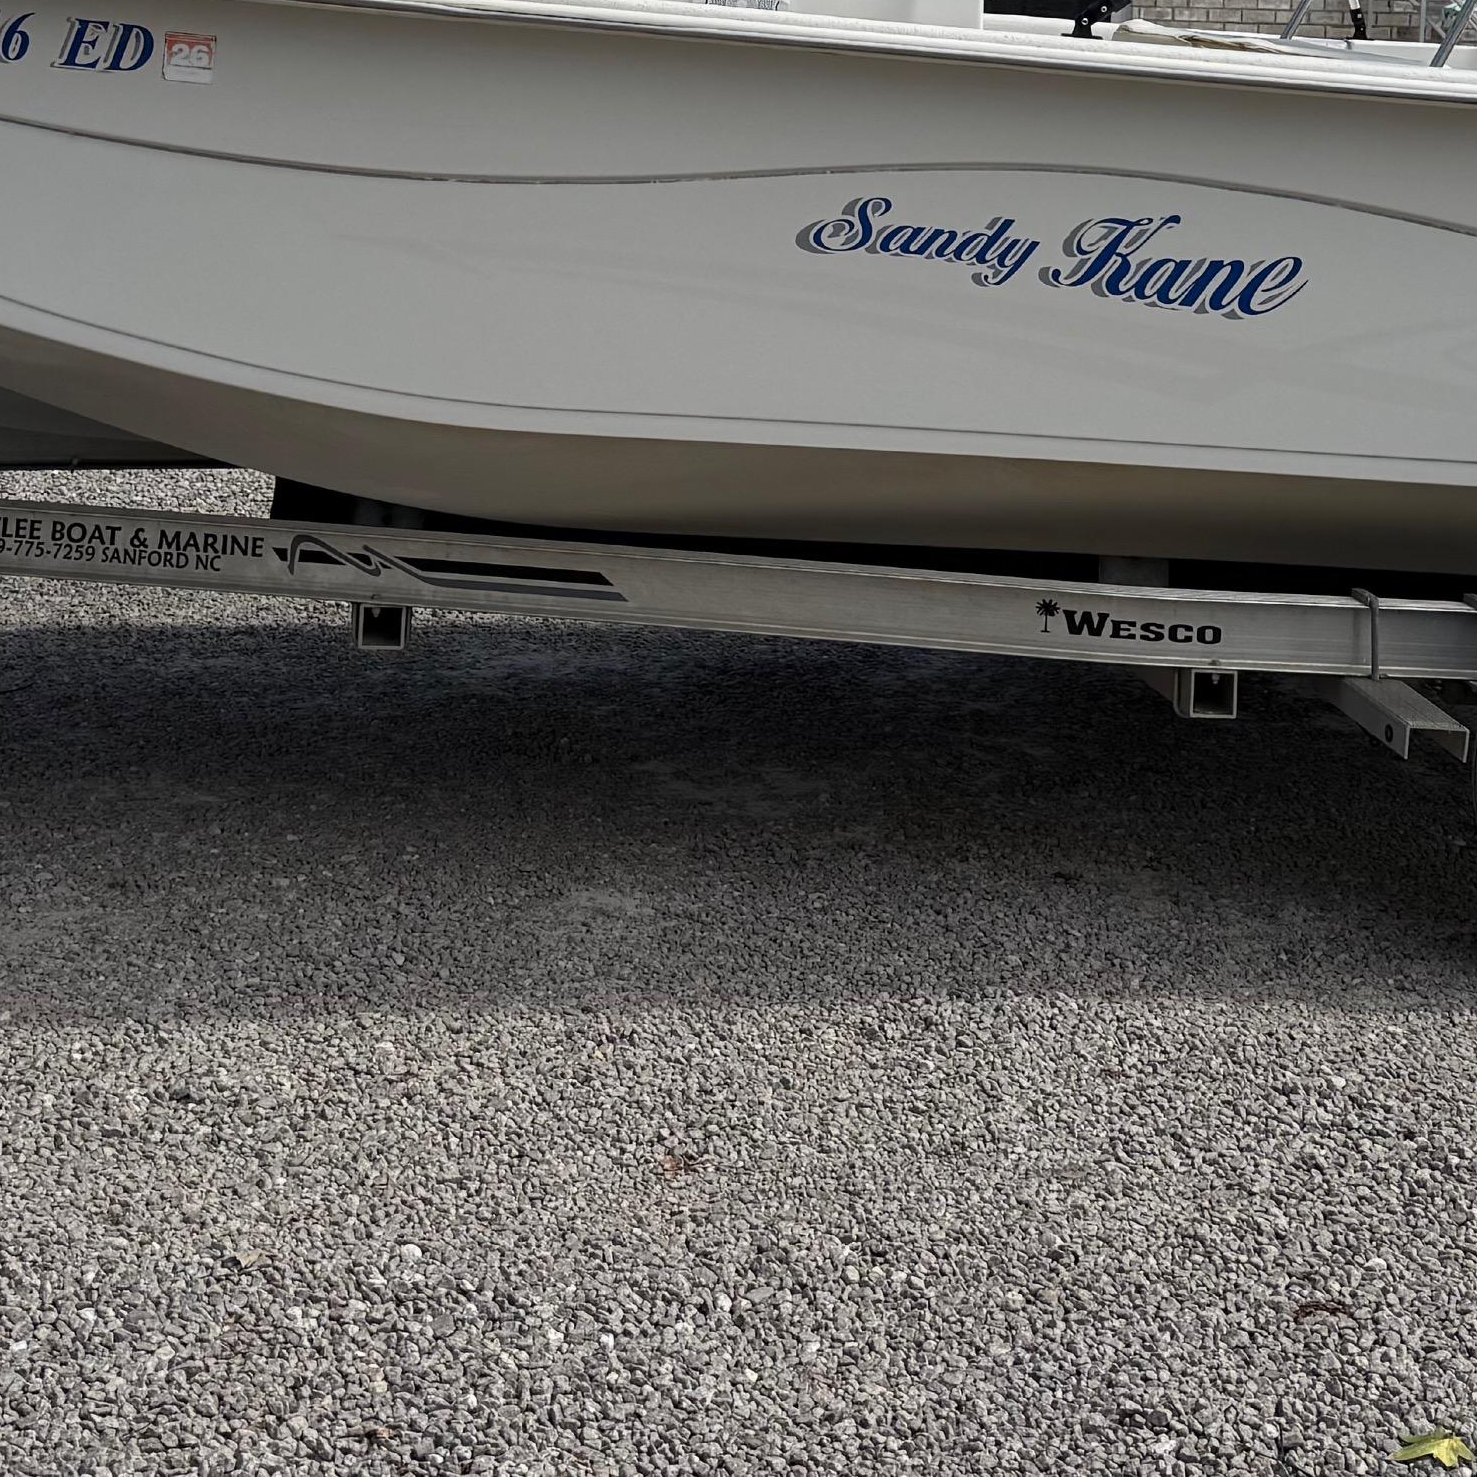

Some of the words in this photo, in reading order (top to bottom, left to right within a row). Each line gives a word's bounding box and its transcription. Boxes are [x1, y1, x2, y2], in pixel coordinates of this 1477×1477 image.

[52, 16, 156, 73] ED
[170, 43, 210, 68] 26
[796, 195, 1041, 288] Sandy
[1038, 214, 1309, 320] Kane
[52, 519, 122, 546] BOAT
[129, 525, 148, 549] &
[157, 528, 265, 559] MARINE
[100, 544, 191, 571] SANFORD
[194, 553, 221, 573] NC
